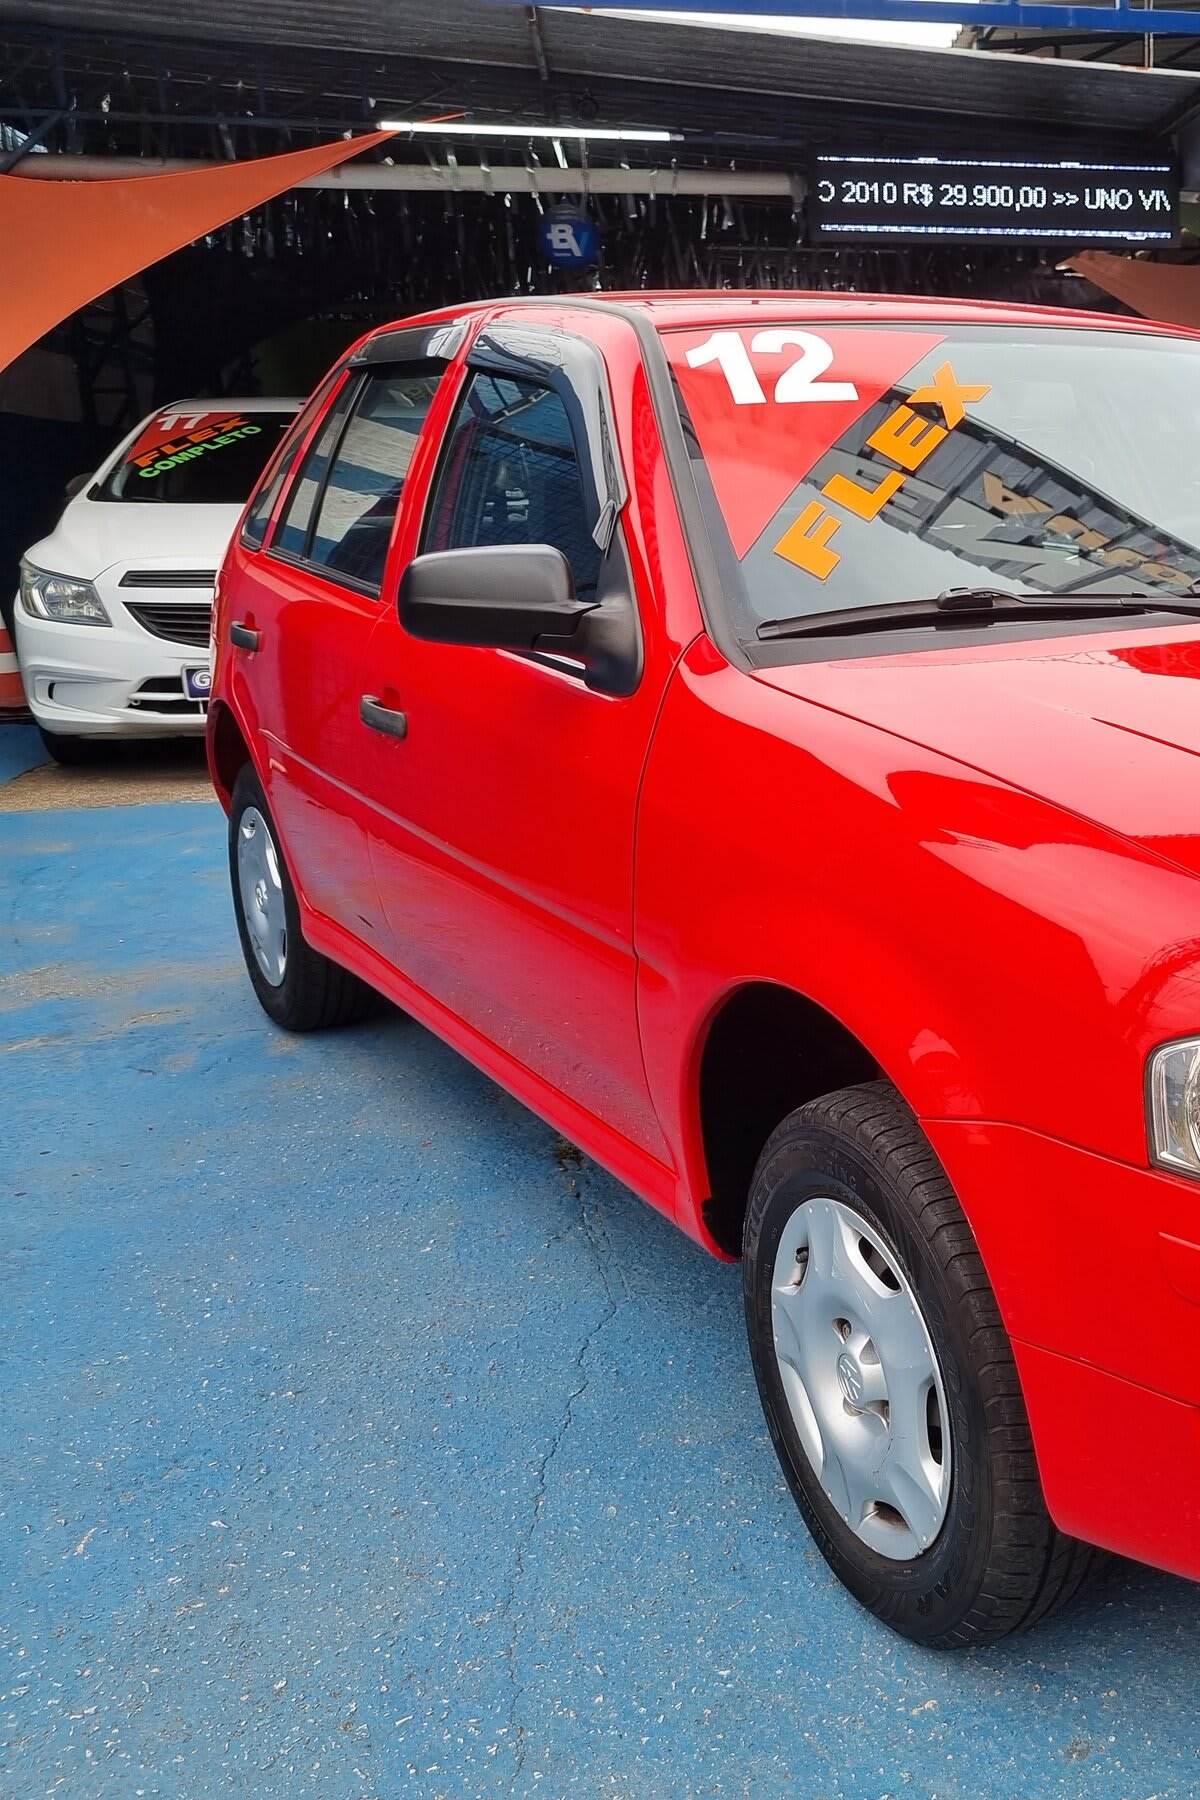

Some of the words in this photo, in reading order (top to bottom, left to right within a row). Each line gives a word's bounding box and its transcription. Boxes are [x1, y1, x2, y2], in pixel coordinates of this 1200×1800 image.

[841, 181, 897, 204] 2010
[903, 182, 933, 208] R$
[939, 184, 1047, 212] 29.900,00
[1084, 187, 1131, 212] UNO
[685, 329, 859, 405] 12
[133, 416, 251, 468] FLEX
[156, 412, 210, 432] 17
[139, 425, 263, 478] COMPLETO
[773, 360, 993, 583] FLEX
